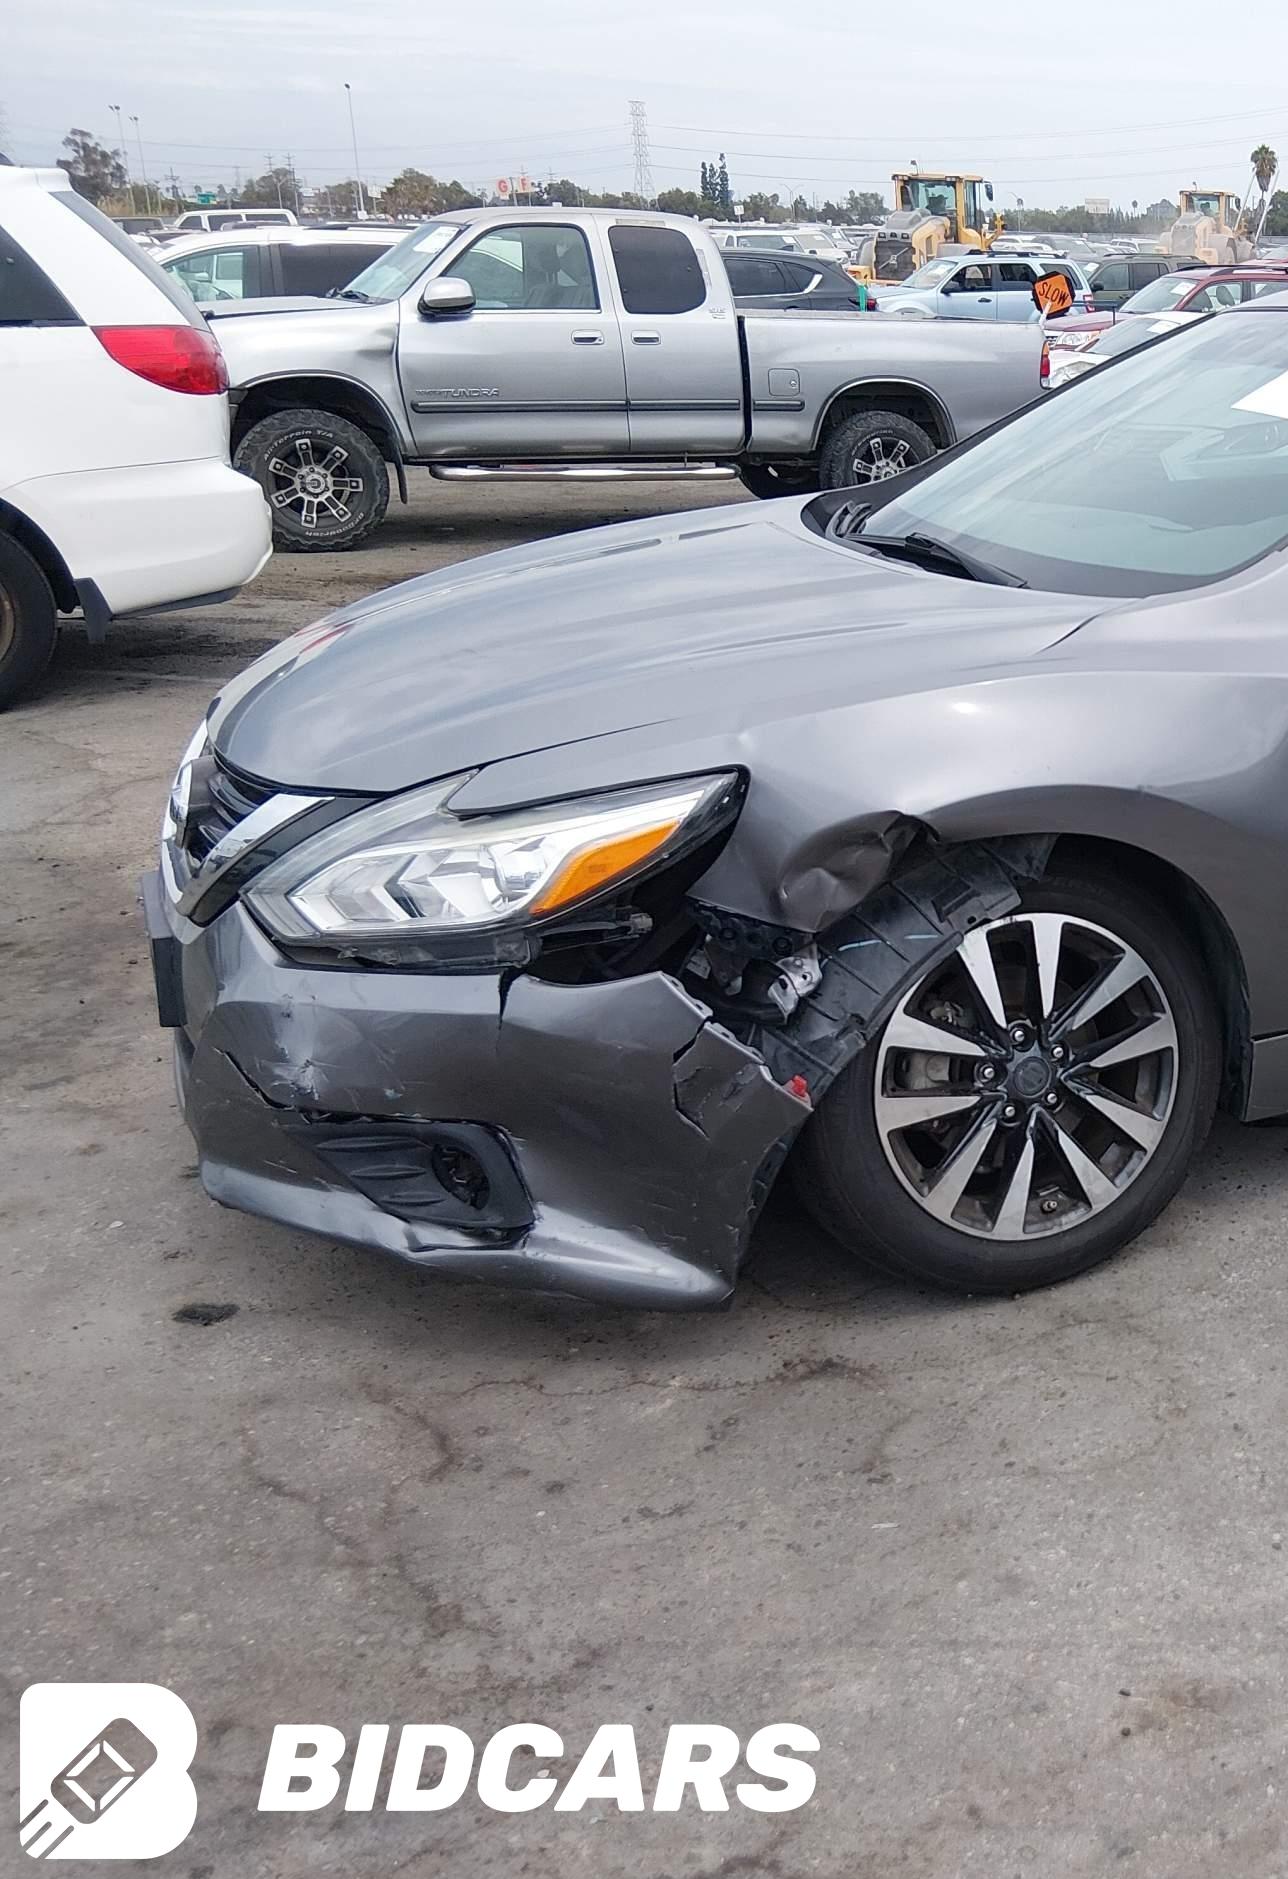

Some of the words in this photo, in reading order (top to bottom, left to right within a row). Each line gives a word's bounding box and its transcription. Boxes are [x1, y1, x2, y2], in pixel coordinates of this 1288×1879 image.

[498, 180, 508, 193] G
[1038, 281, 1069, 306] SLOW
[441, 388, 499, 398] TUNDRA
